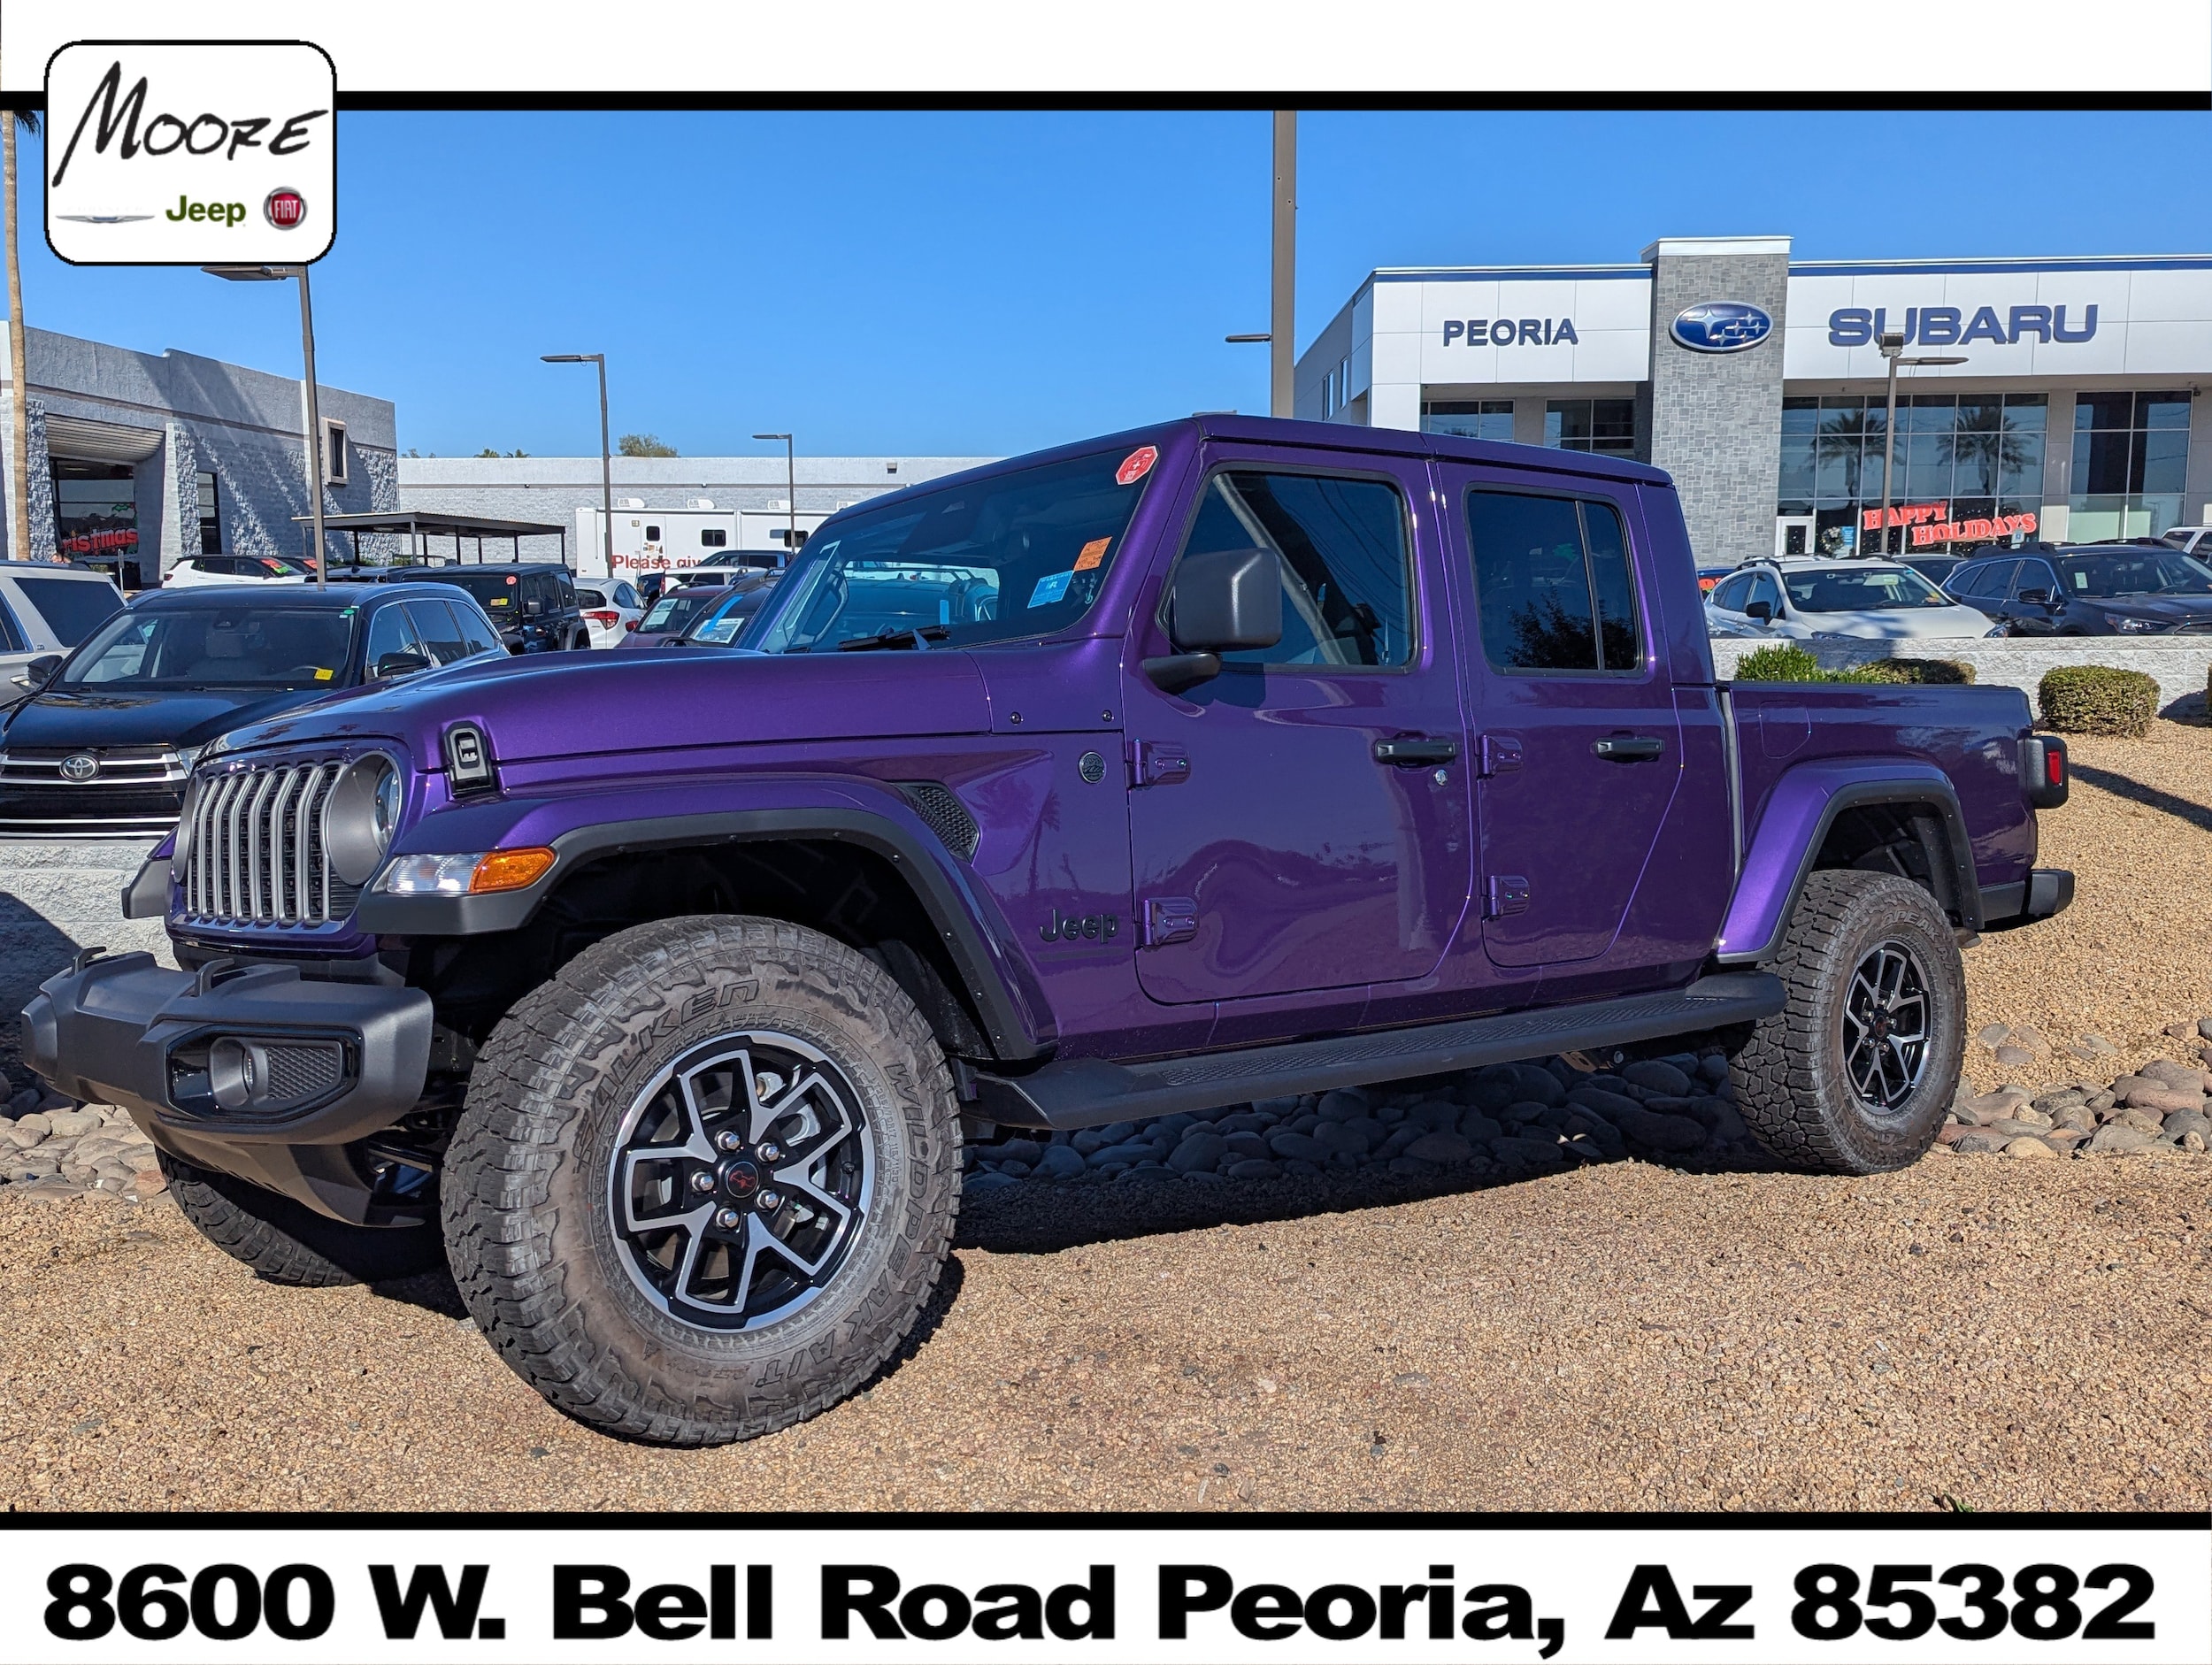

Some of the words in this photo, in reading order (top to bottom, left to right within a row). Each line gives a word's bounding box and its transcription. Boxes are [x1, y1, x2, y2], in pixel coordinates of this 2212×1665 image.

[1444, 318, 1578, 347] PEORIA
[1829, 305, 2098, 347] SUBARU
[1863, 501, 1948, 530] HAPPY
[1912, 513, 2037, 546] HOLIDAYS
[611, 555, 671, 570] Please
[1040, 909, 1118, 944] Jeep
